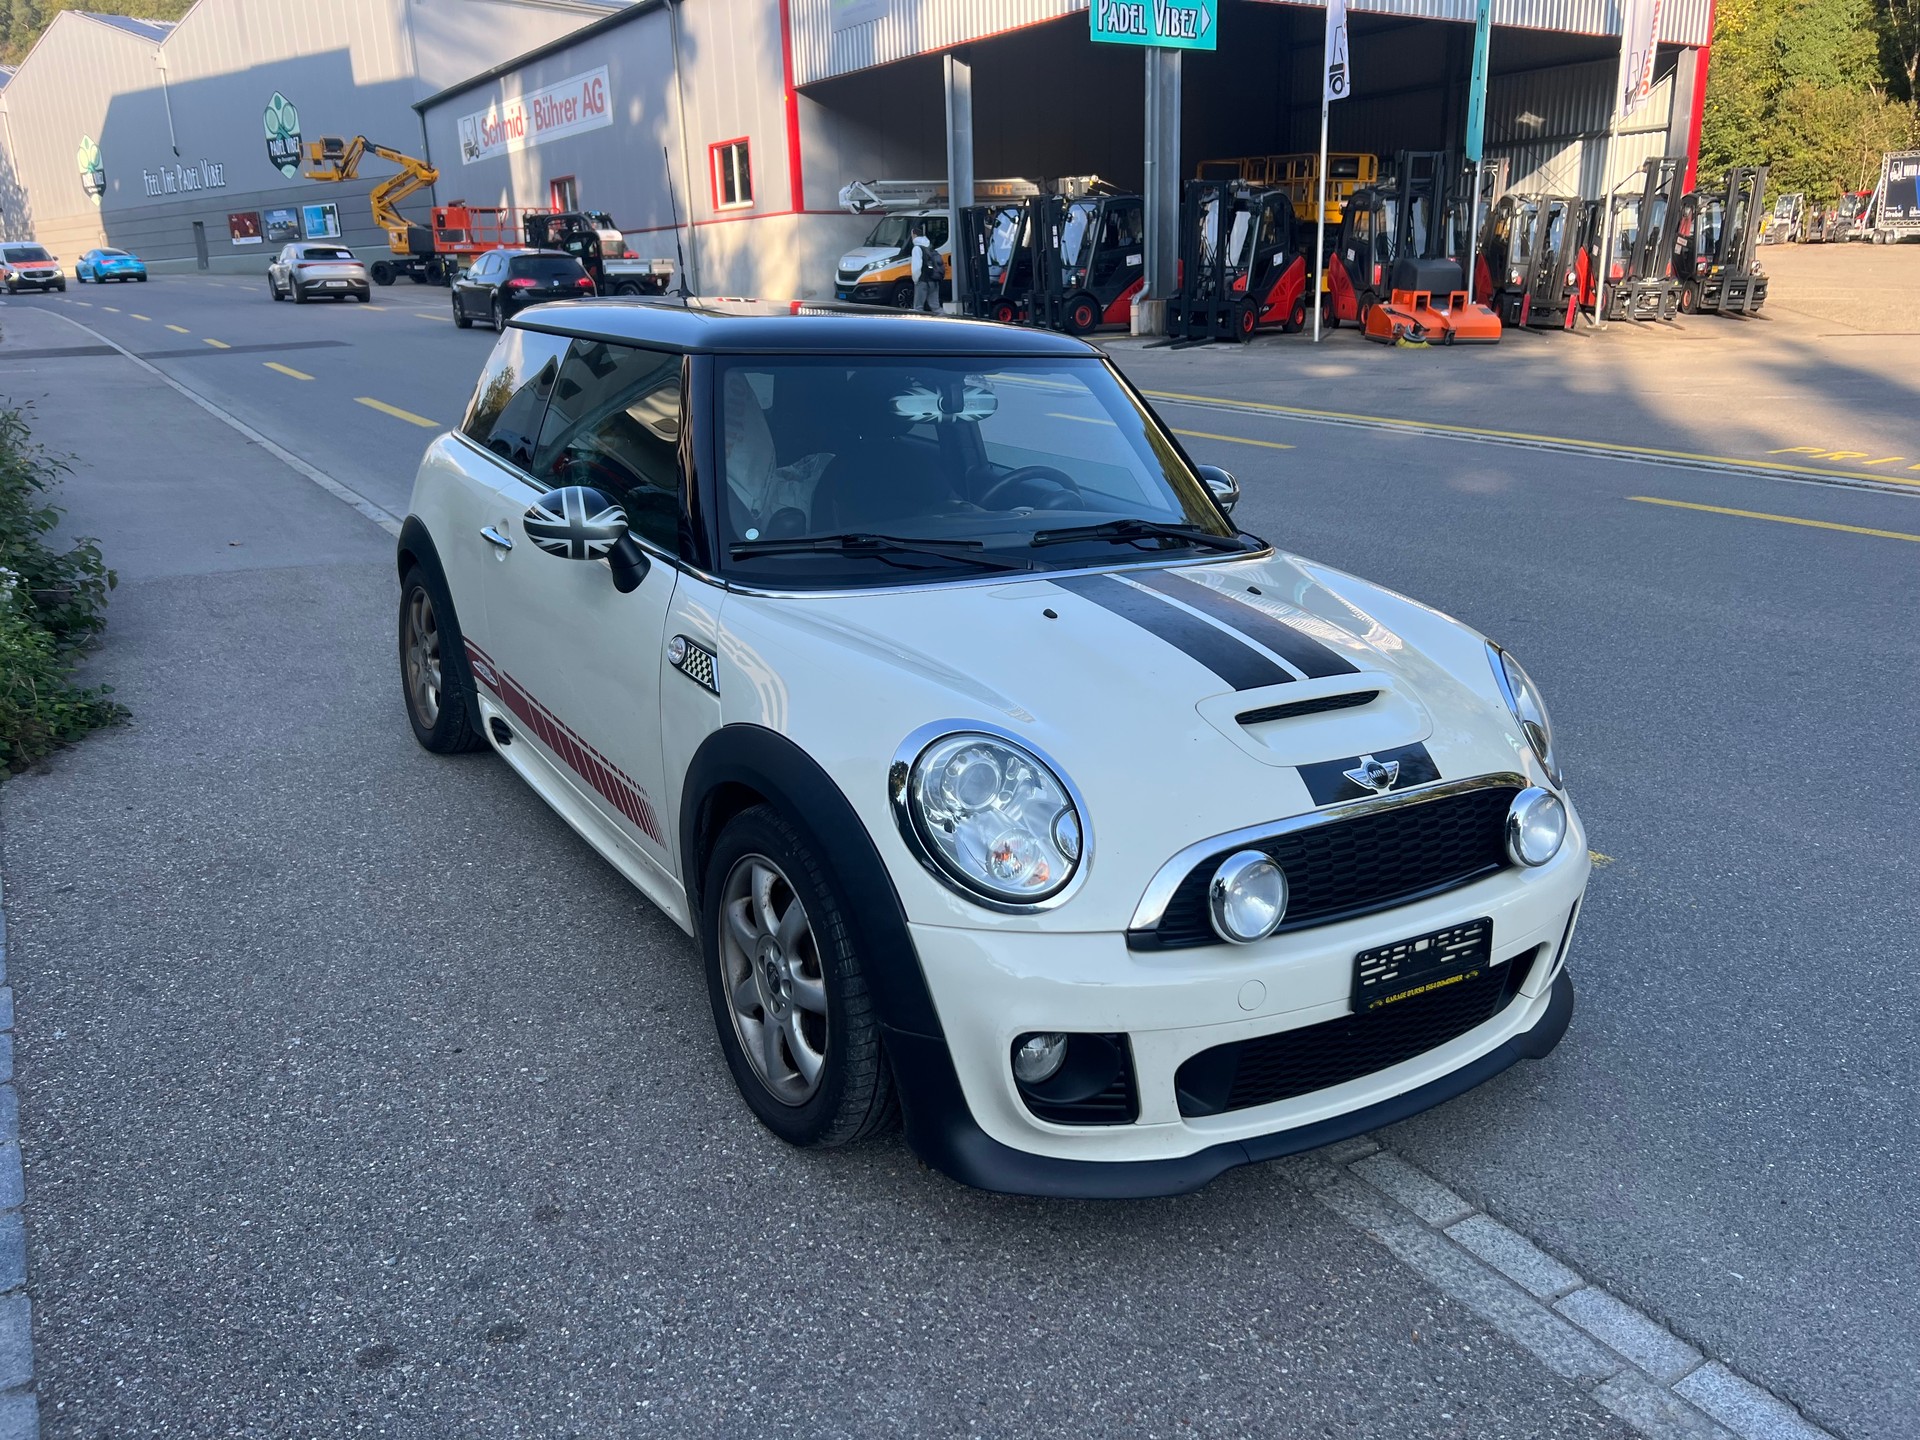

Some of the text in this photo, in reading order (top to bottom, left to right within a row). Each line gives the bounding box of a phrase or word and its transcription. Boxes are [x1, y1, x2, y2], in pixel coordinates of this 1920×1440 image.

[1097, 0, 1198, 39] PADEL VIBEZ
[480, 106, 524, 147] Schmid
[533, 94, 578, 132] Bührer
[582, 78, 605, 117] AG
[177, 164, 202, 192] PADEL
[200, 158, 226, 188] VIBEZ
